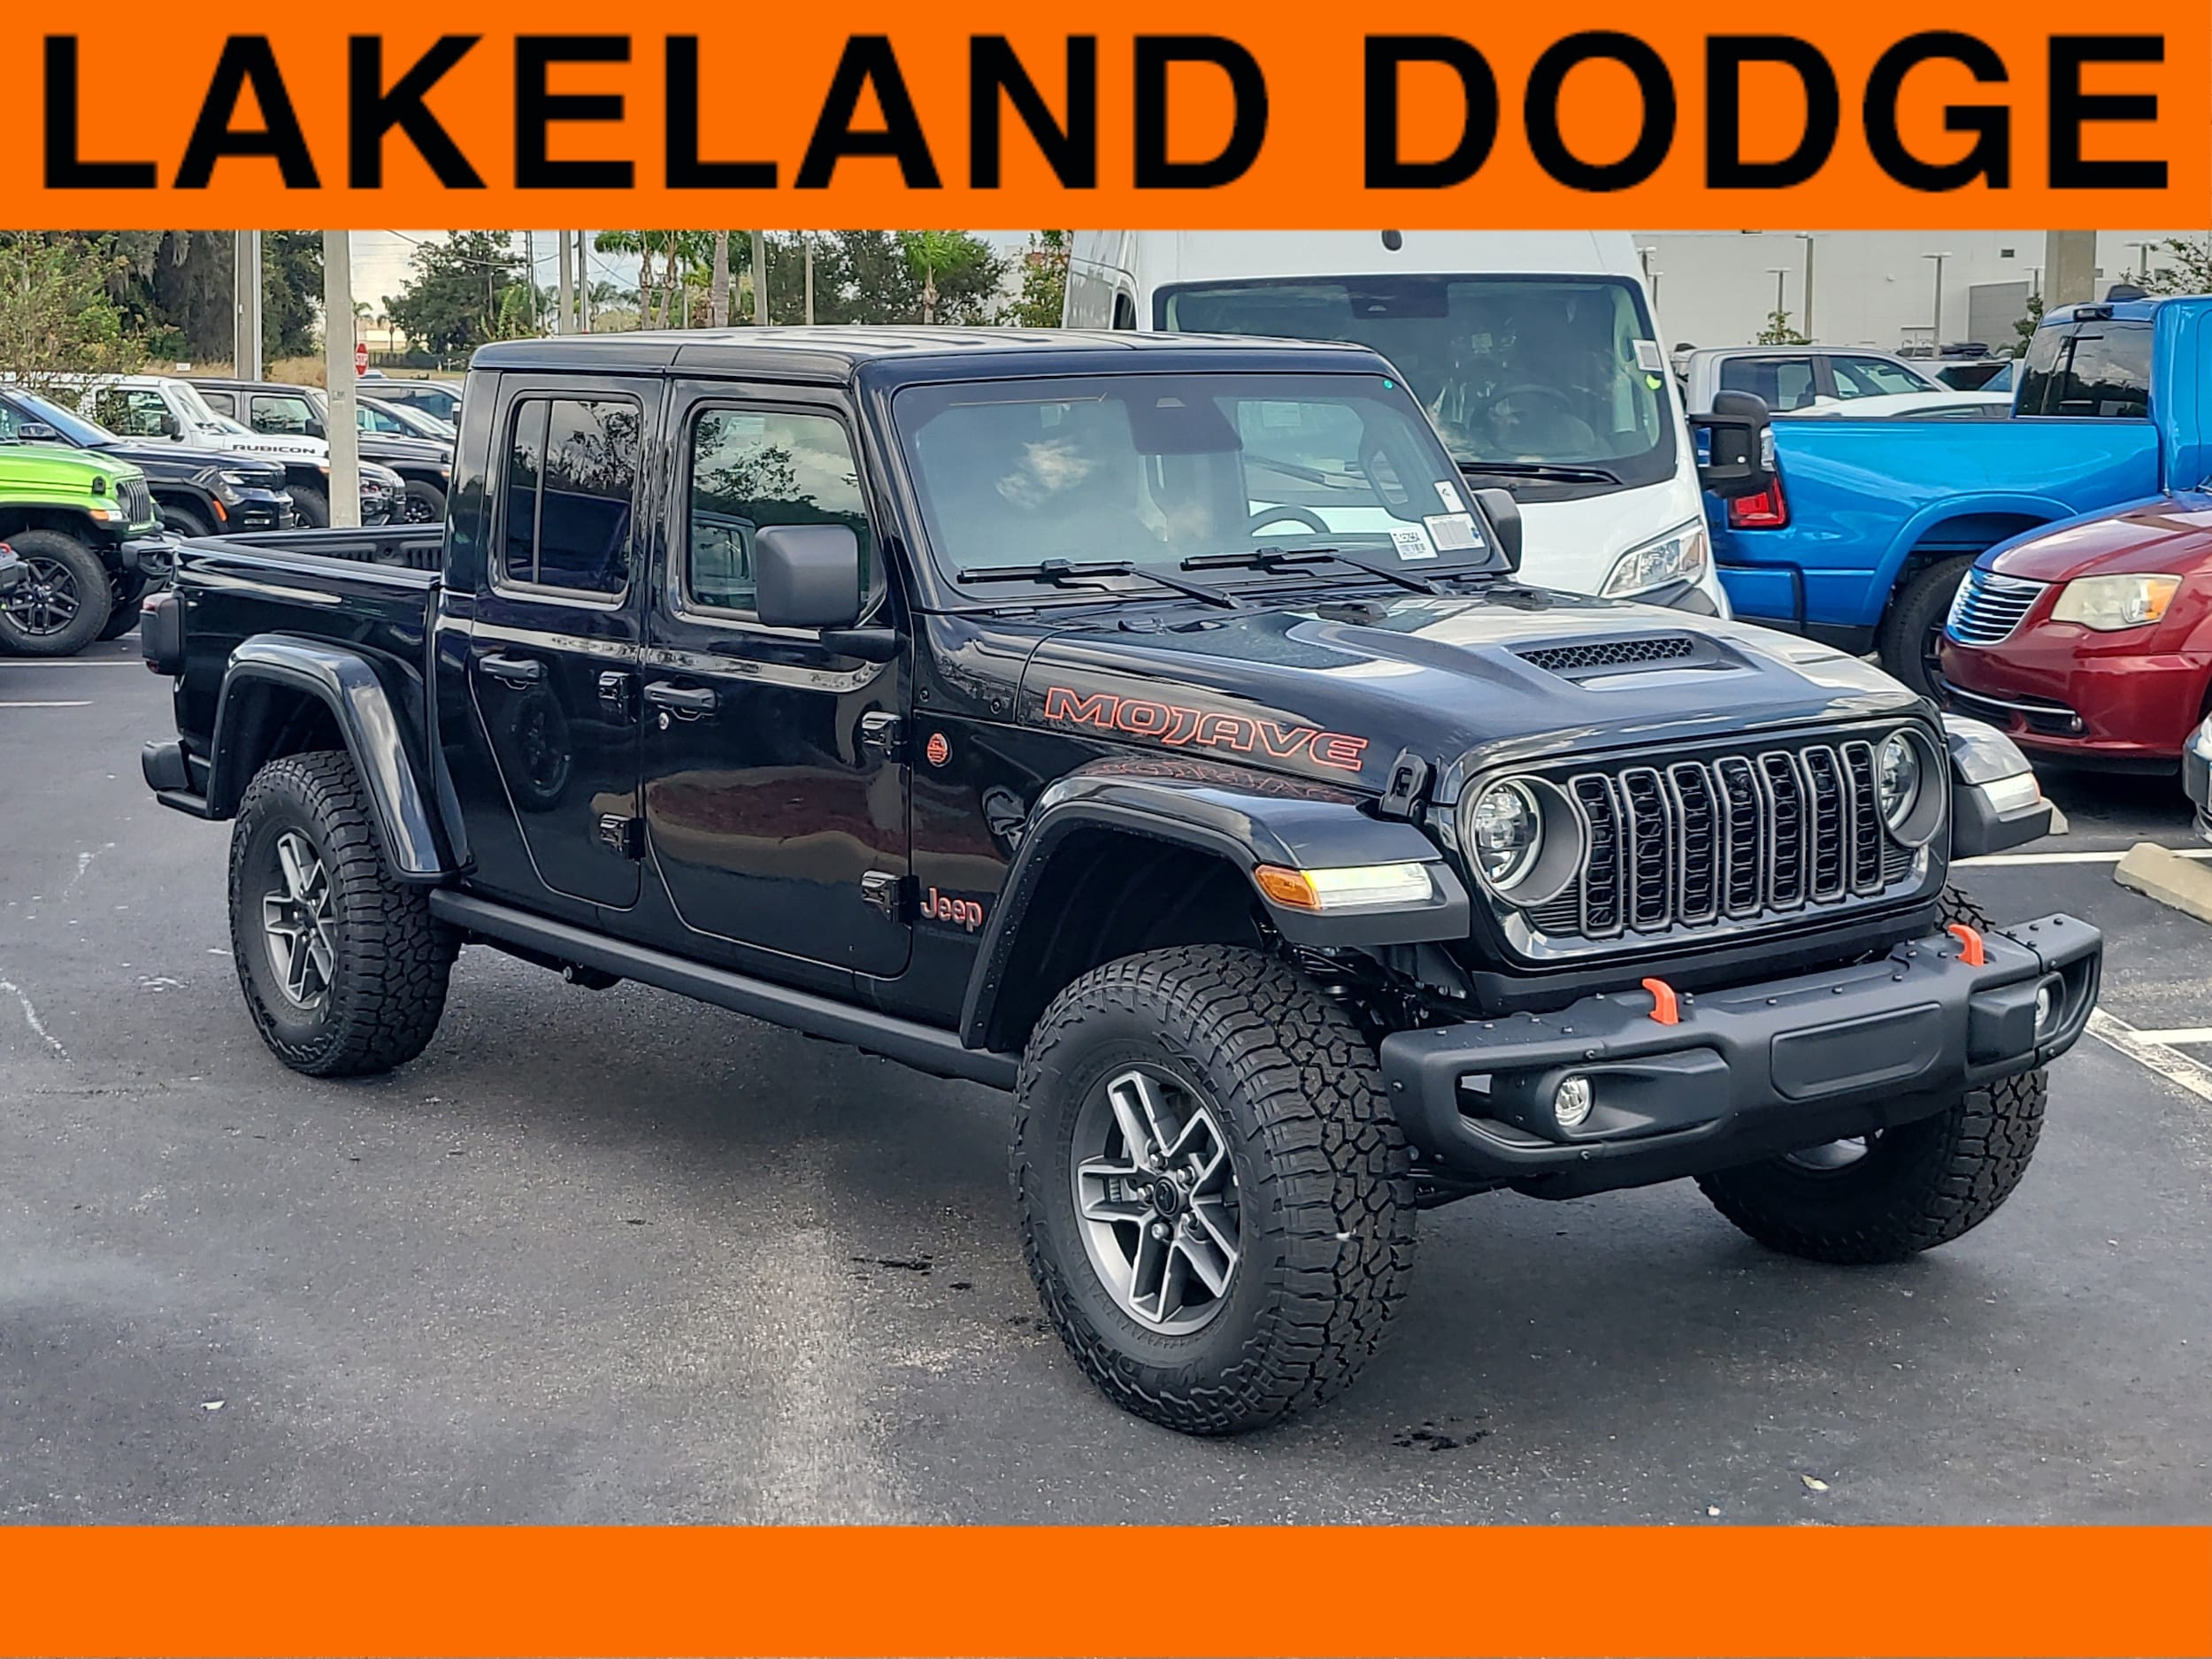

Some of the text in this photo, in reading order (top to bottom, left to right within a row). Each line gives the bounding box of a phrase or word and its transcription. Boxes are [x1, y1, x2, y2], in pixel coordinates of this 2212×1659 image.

[233, 444, 316, 454] RUBICON
[1044, 687, 1368, 772] MOJAVE
[920, 887, 983, 933] Jeep
